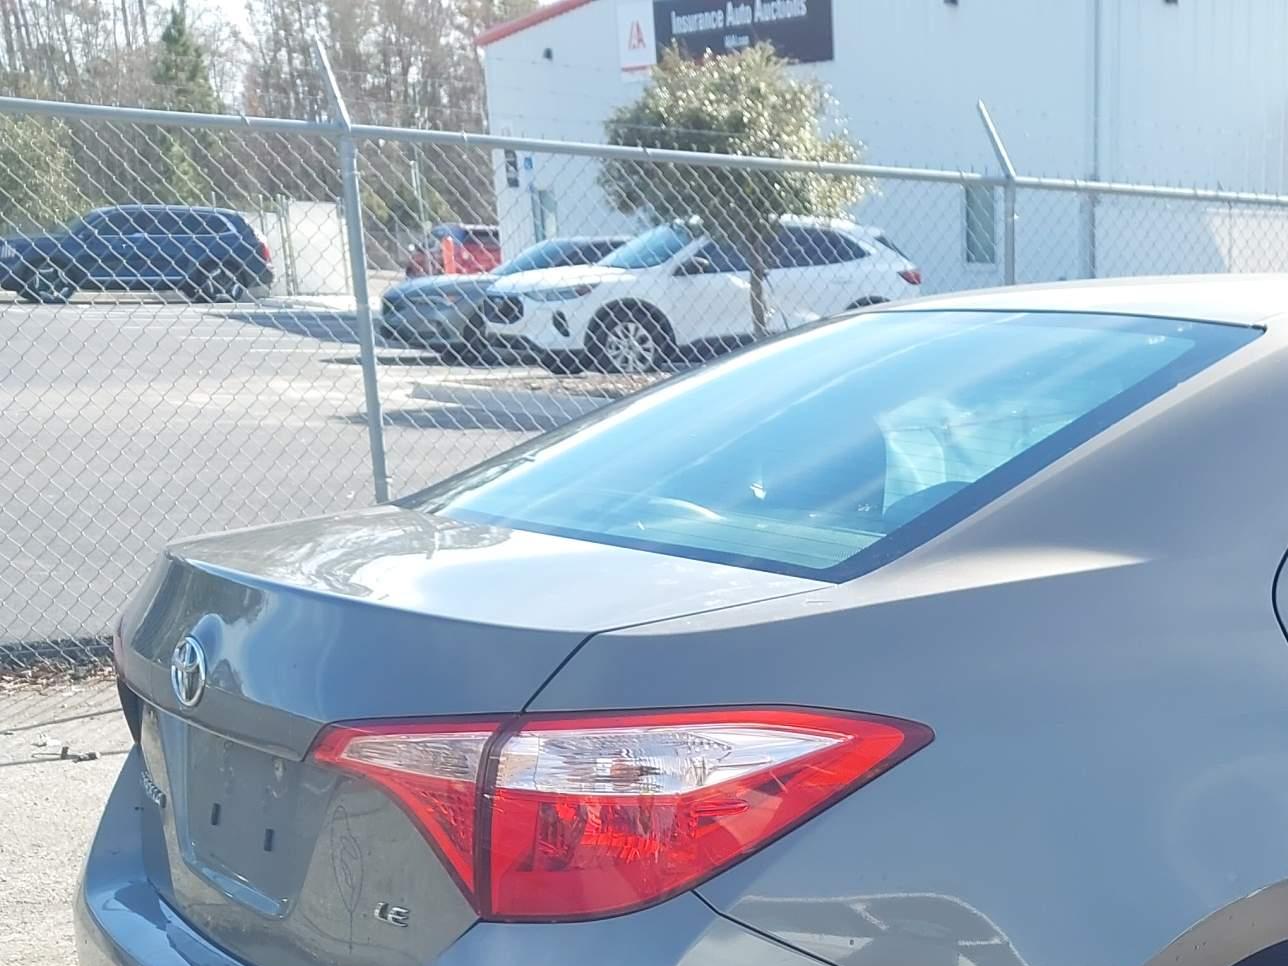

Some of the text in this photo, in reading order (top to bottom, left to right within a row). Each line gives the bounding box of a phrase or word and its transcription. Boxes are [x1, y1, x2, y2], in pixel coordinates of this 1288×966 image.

[671, 9, 724, 34] Insurance
[725, 1, 752, 26] Auto
[753, 0, 807, 22] Auctions
[374, 901, 409, 927] LE
